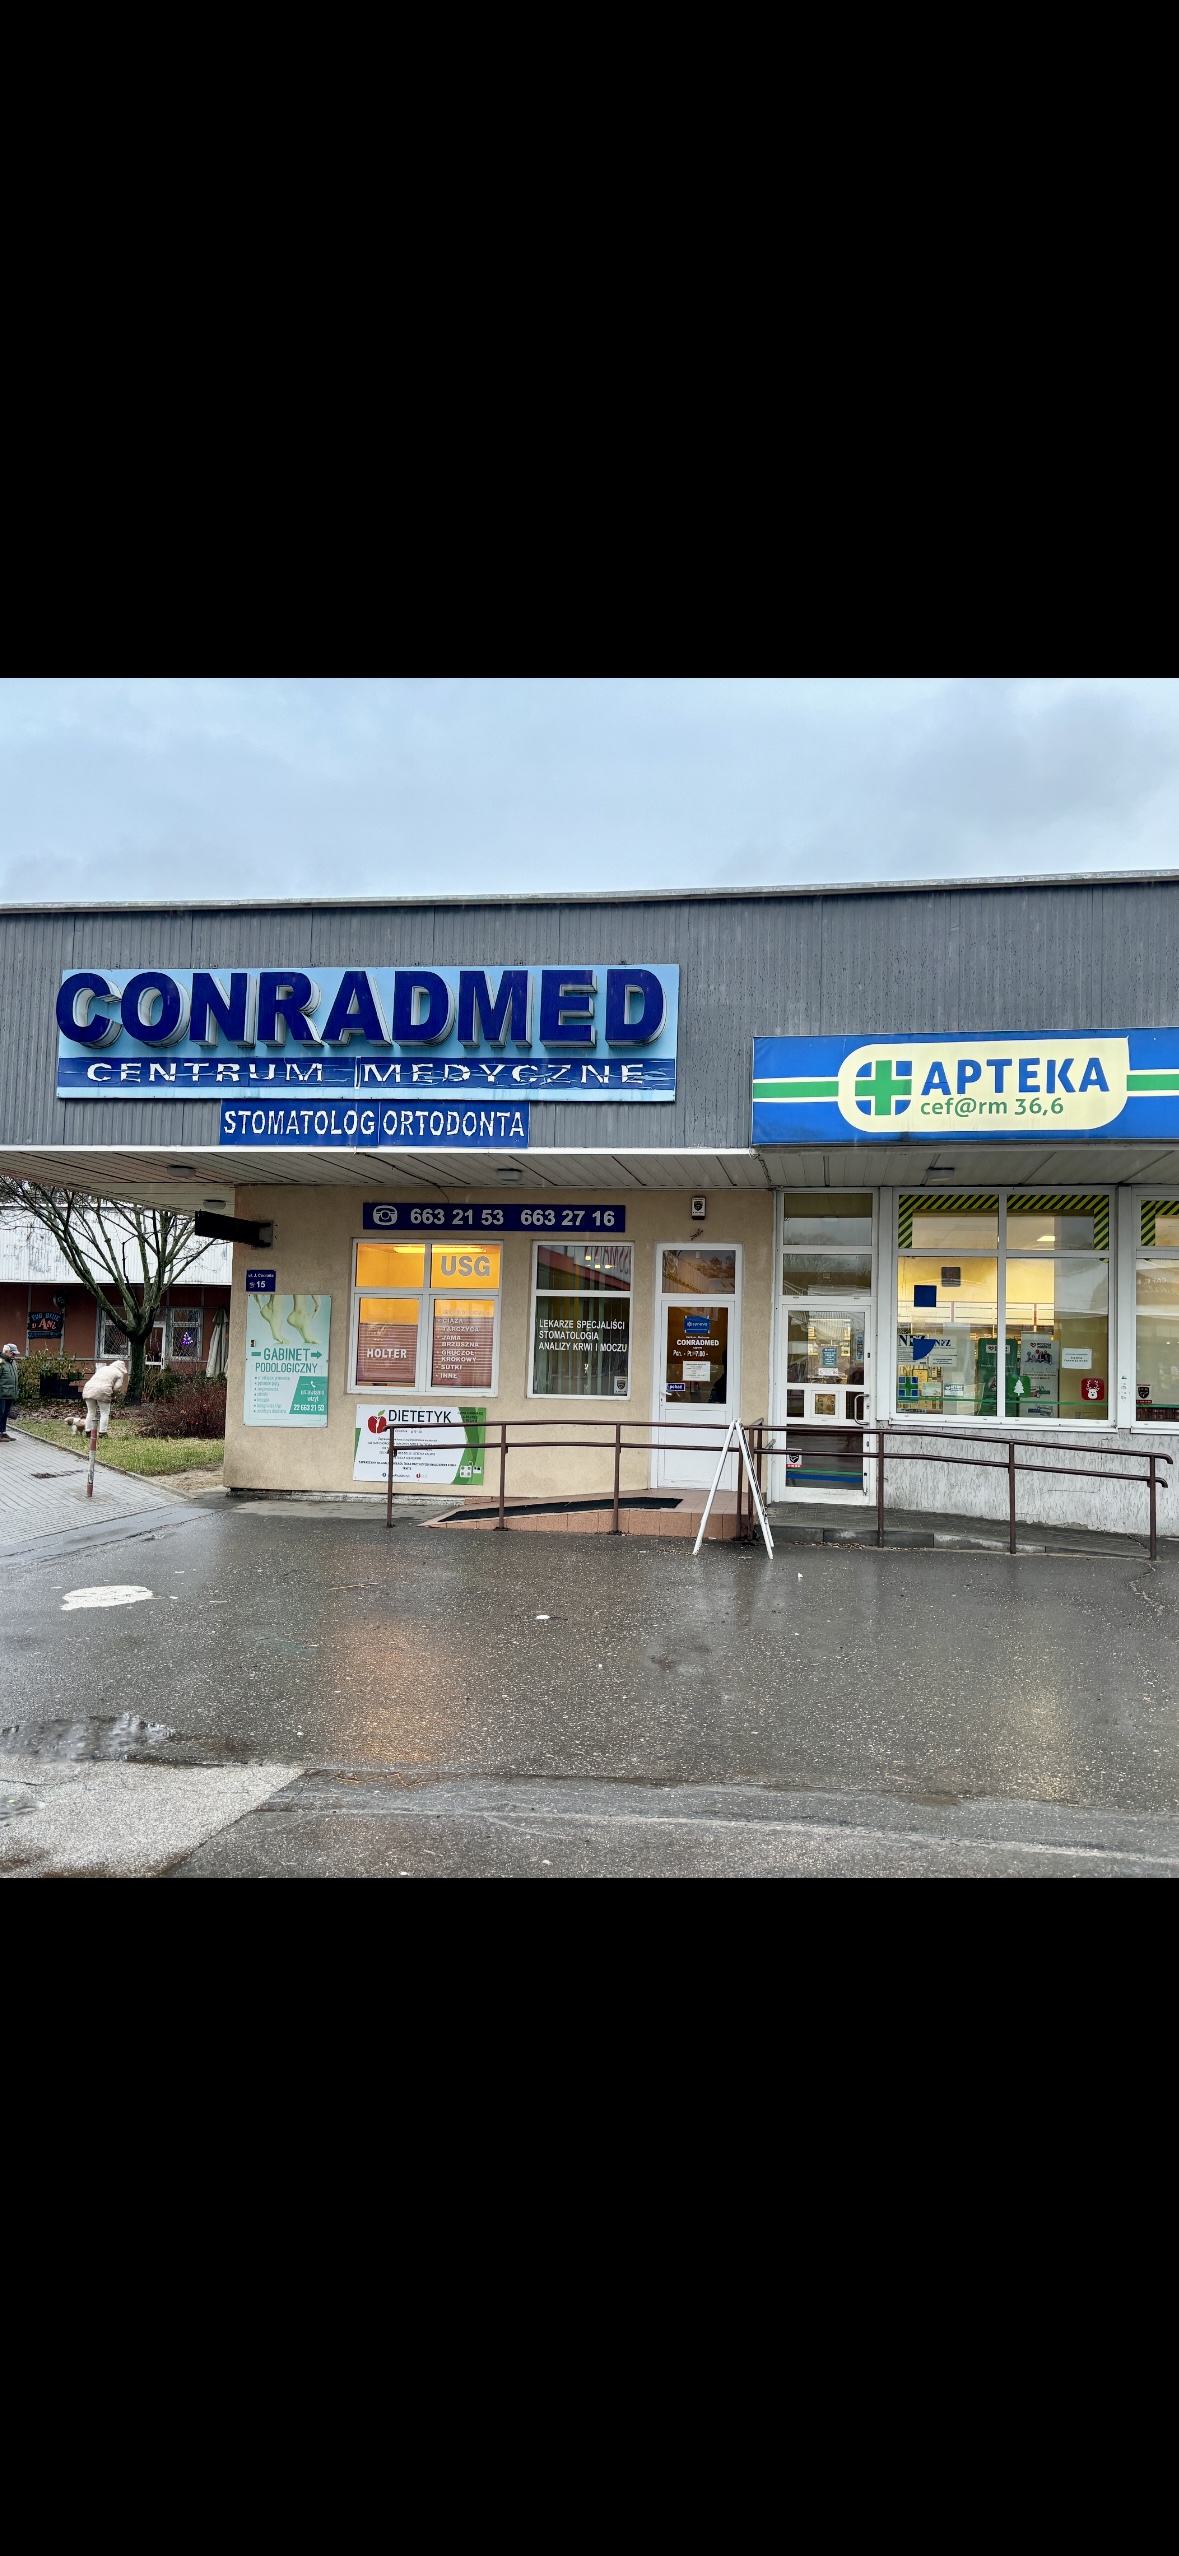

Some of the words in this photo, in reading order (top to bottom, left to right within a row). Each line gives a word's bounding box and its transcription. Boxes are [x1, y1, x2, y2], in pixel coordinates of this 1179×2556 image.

[56, 968, 666, 1046] CONRADMED
[86, 1062, 326, 1084] CENTRUM
[363, 1062, 645, 1085] MEDYCZNE
[920, 1057, 1110, 1096] APTEKA
[920, 1097, 1008, 1118] cef@rm
[1014, 1097, 1064, 1118] 36,6
[223, 1109, 377, 1137] STOMATOLOG
[381, 1109, 526, 1137] ORTODONTA
[410, 1208, 445, 1225] 663
[452, 1209, 473, 1225] 21
[481, 1209, 504, 1225] 53
[520, 1209, 556, 1226] 663
[561, 1210, 584, 1226] 27
[592, 1210, 615, 1226] 16
[441, 1255, 491, 1277] USG
[256, 1280, 266, 1288] 15
[539, 1319, 574, 1329] LEKARZE
[576, 1318, 625, 1330] SPECJALIŚCI
[539, 1330, 599, 1340] STOMATOLOGIA
[366, 1348, 407, 1359] HOLTER
[538, 1341, 571, 1351] ANALIZY
[573, 1342, 593, 1351] KRWI
[595, 1343, 598, 1351] I
[600, 1343, 627, 1352] MOCZU
[263, 1347, 311, 1361] GABINET
[255, 1362, 318, 1374] PODOLOGICZNY
[388, 1409, 452, 1423] DIETETYK
